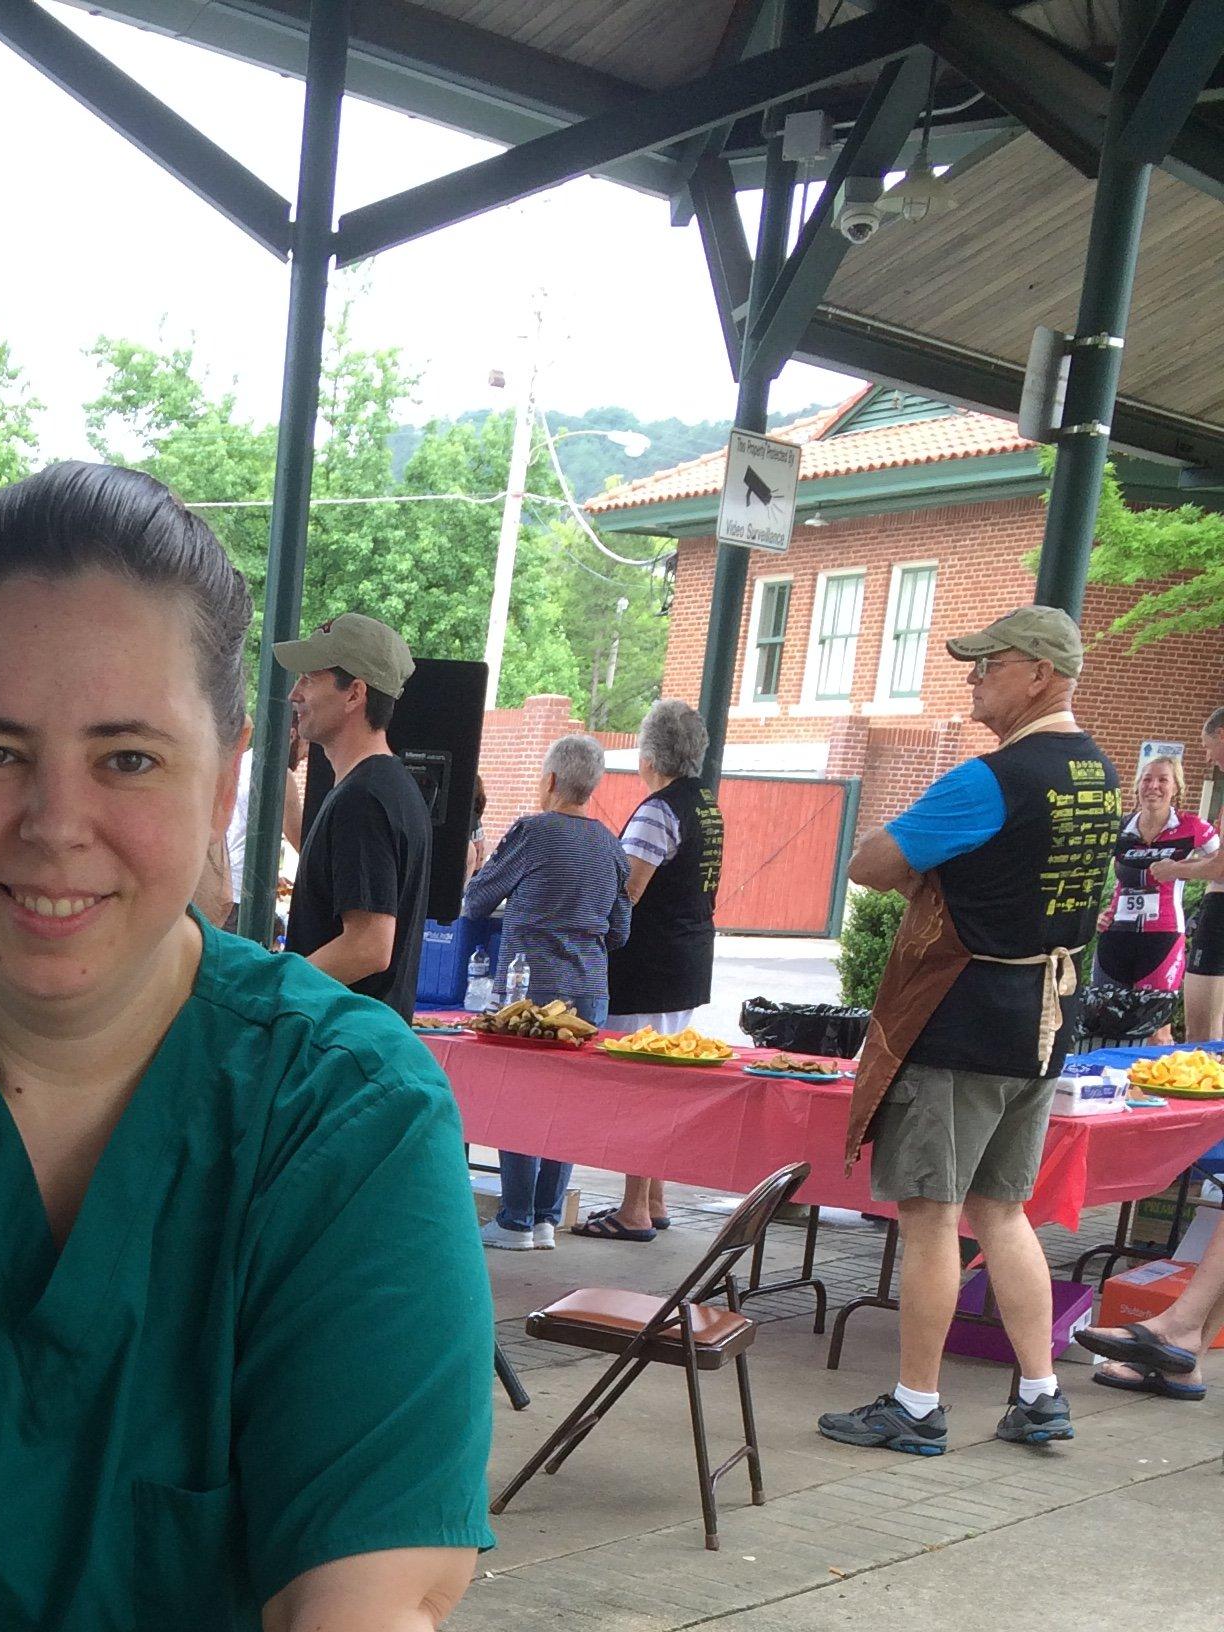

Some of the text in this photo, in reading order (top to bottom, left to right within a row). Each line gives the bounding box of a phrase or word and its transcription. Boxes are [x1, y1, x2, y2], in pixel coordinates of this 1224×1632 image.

[726, 519, 785, 545] Video Surveillance
[1126, 895, 1145, 911] 59
